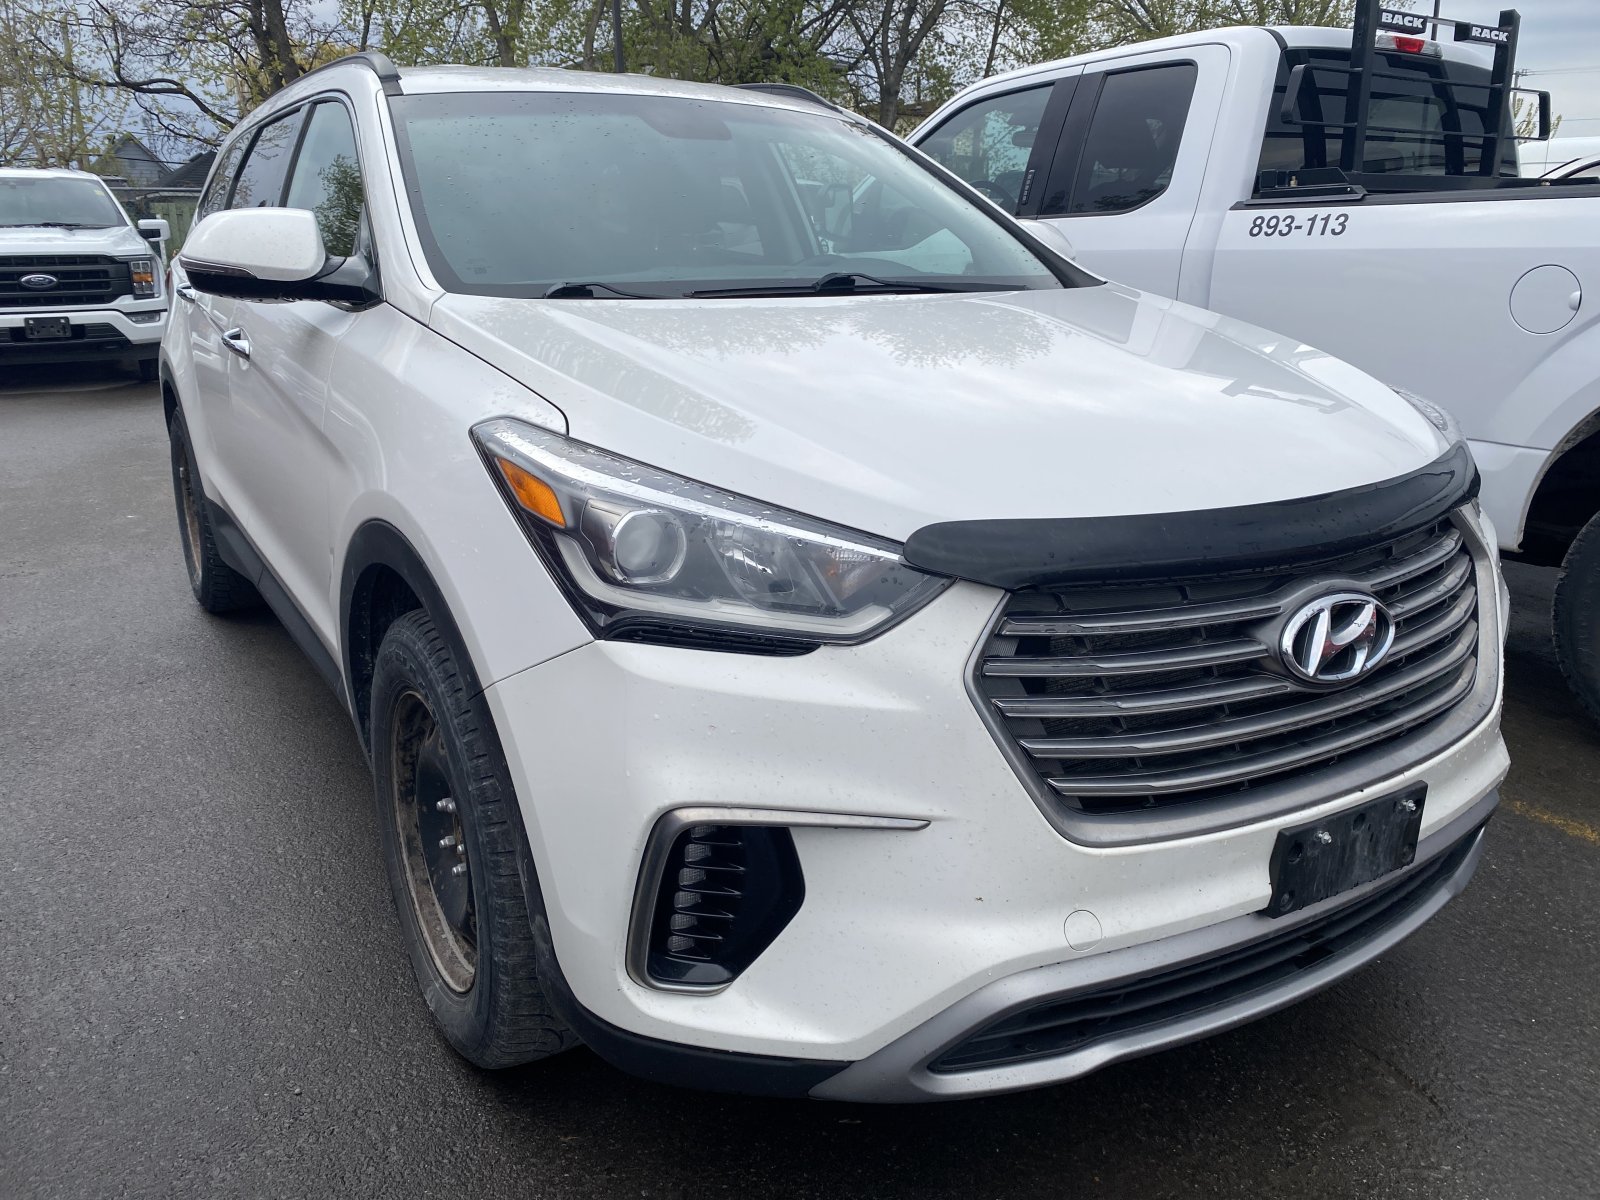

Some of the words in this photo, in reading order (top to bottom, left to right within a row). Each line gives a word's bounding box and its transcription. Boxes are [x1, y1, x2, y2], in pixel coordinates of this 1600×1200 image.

[1381, 12, 1424, 29] BACK
[1471, 26, 1509, 42] RACK
[1249, 213, 1349, 237] 893-113
